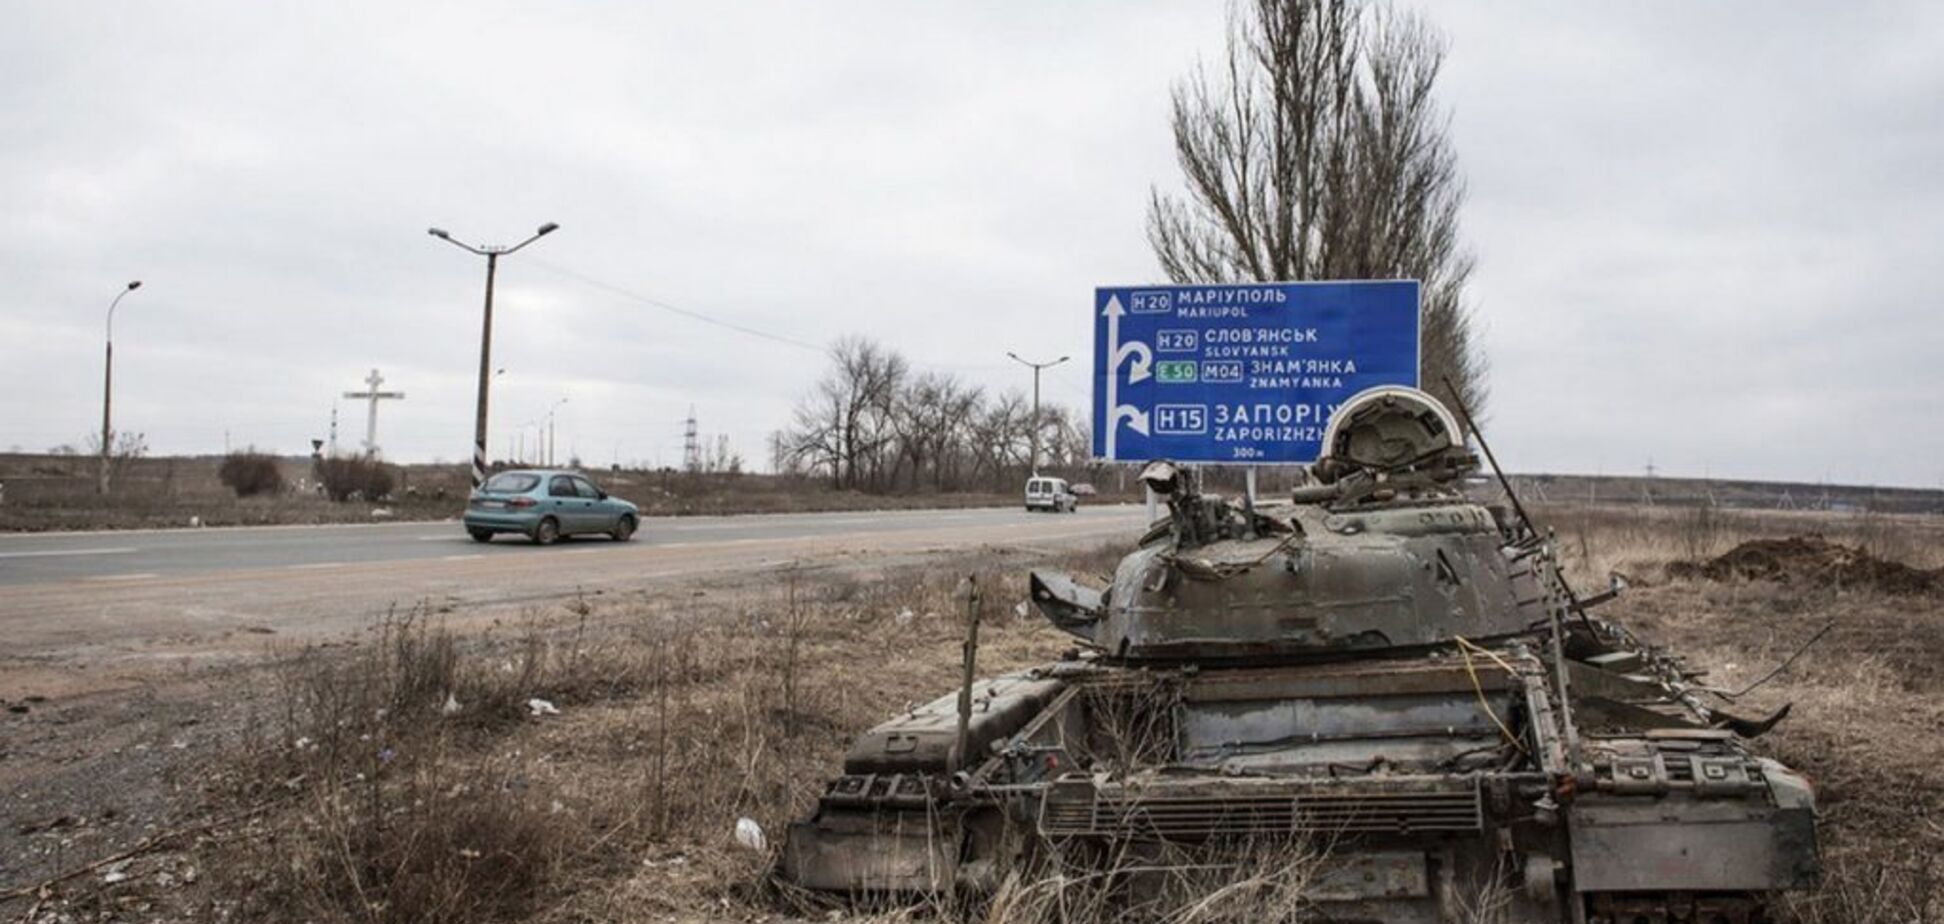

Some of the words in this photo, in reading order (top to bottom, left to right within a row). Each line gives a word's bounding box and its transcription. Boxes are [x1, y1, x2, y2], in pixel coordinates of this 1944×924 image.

[1178, 289, 1287, 304] МАРІУПОЛЬ
[1178, 307, 1248, 318] MARIUPOL
[1205, 328, 1318, 343] СЛОВ'ЯНСЬК
[1205, 346, 1289, 358] SLOVYANSK
[1251, 360, 1356, 373] ЗНАМ'ЯНКА
[1250, 377, 1343, 388] ZNAMYANKA
